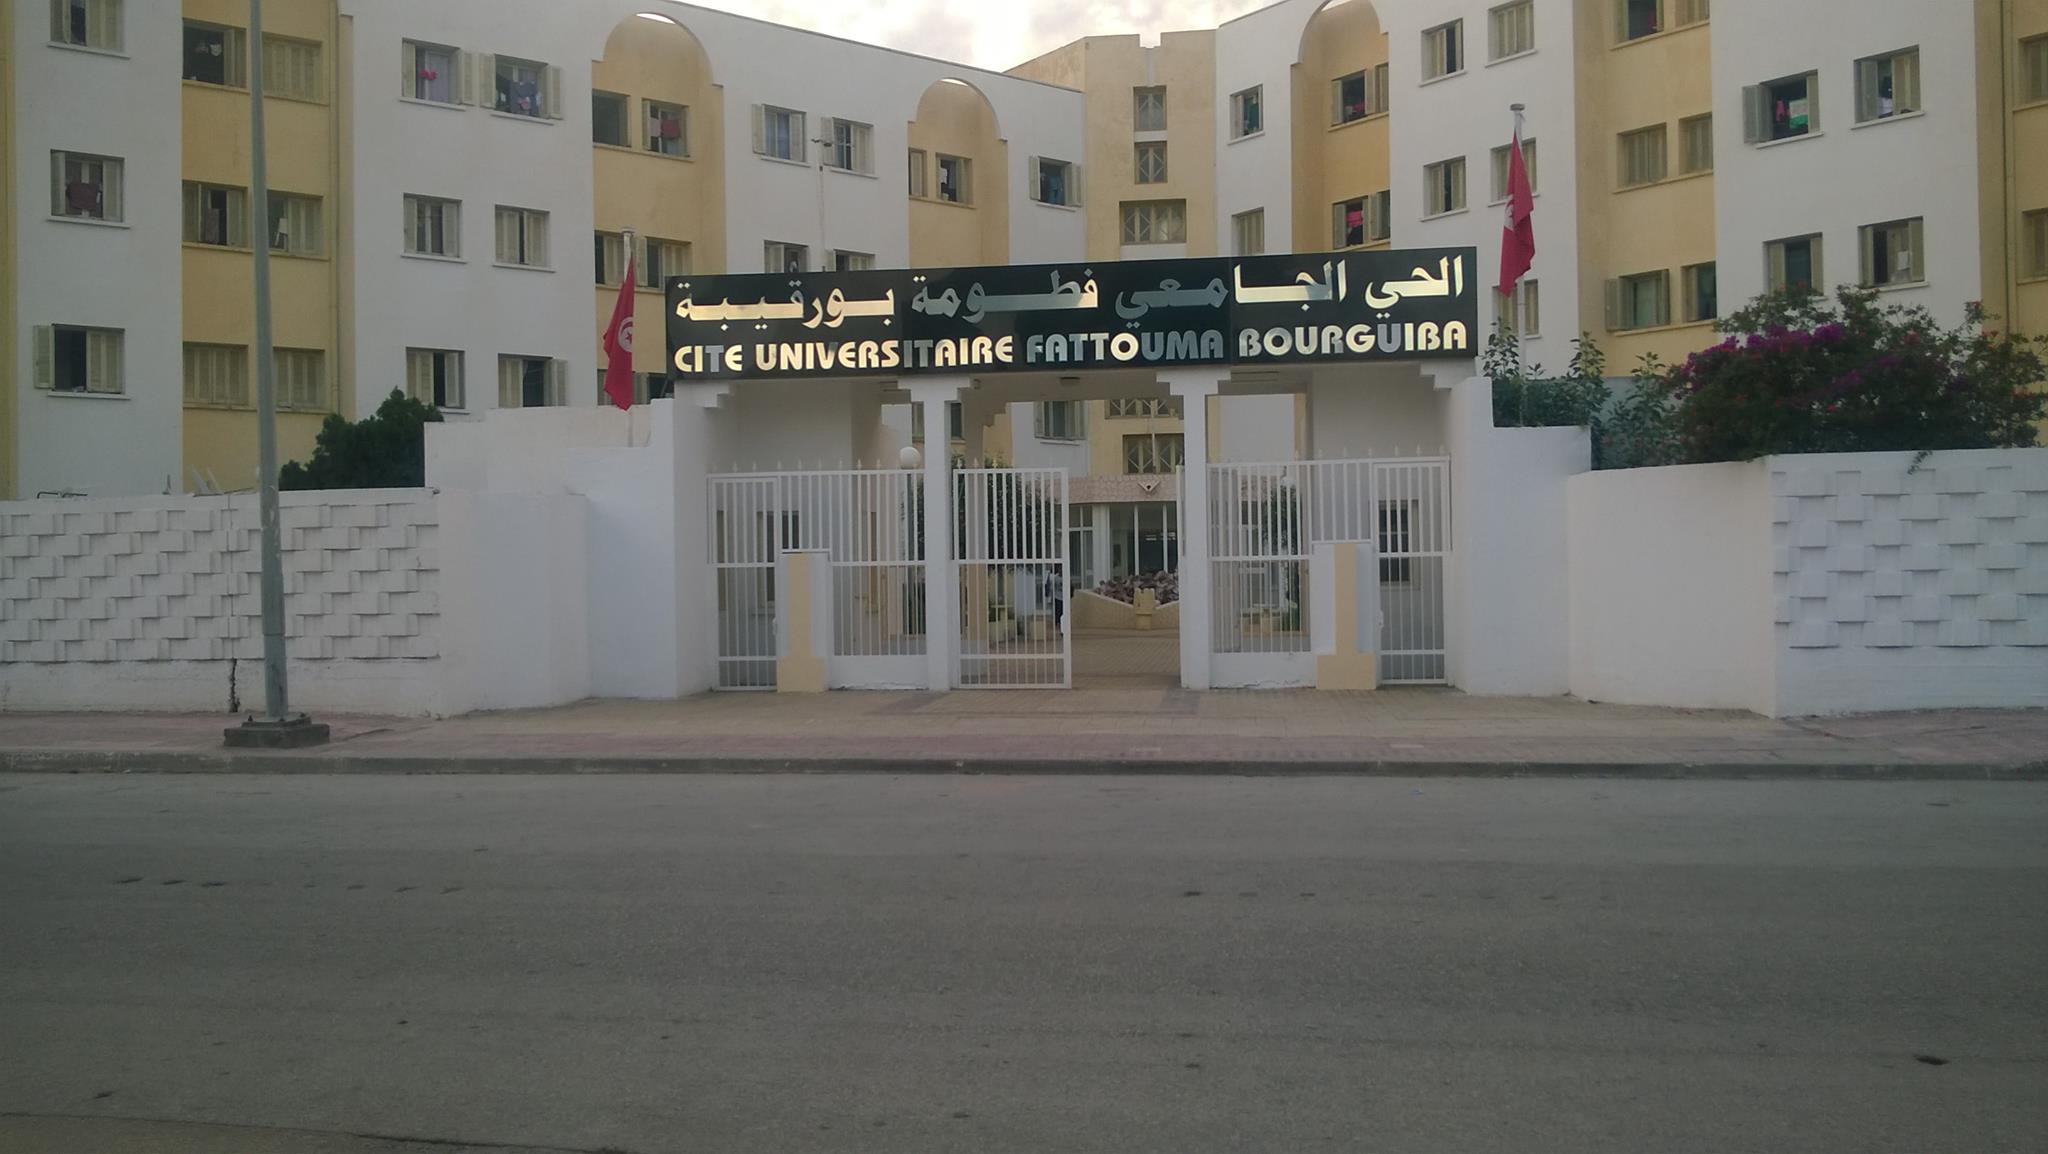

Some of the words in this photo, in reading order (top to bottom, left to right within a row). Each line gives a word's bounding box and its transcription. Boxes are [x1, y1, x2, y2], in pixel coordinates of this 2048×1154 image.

[675, 280, 895, 331] بورقيبة
[911, 268, 1099, 324] فطومة
[1115, 259, 1347, 329] الجامعي
[1365, 254, 1464, 319] الحي
[674, 344, 743, 373] CITE
[755, 335, 1014, 371] UNIVERSITAIRE
[1026, 329, 1224, 364] FATTOUMA
